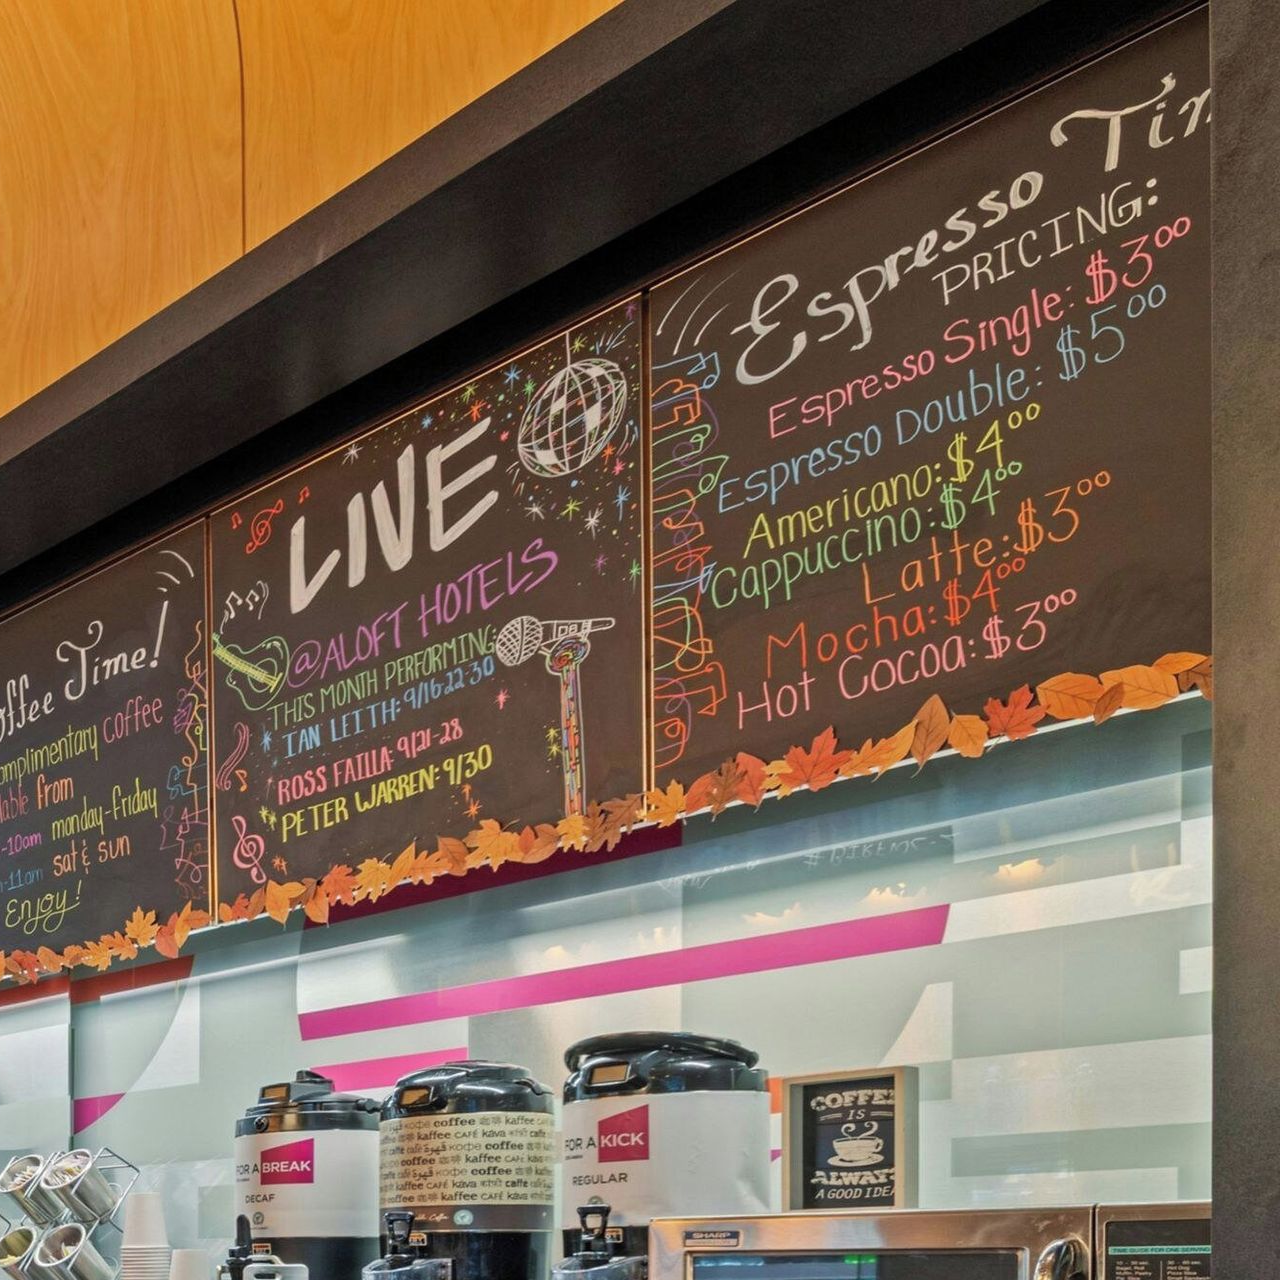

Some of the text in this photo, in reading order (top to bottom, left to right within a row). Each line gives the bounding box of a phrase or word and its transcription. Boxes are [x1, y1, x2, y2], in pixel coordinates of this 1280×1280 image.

[933, 177, 1158, 305] PRICING:
[731, 171, 1043, 385] Espresso
[769, 349, 935, 439] Espresso
[944, 284, 1074, 365] Single:
[717, 423, 882, 514] Espresso
[897, 363, 1042, 445] Double:
[289, 416, 500, 614] LIVE
[743, 462, 942, 558] Americano:
[862, 529, 1011, 604] Latte:
[287, 538, 559, 688] @ALOFT HOTELS
[56, 600, 169, 701] Time!
[767, 606, 937, 679] Mocha:
[267, 626, 499, 732] THIS MONTH PERFORMING:
[738, 671, 815, 730] Hot
[839, 632, 976, 699] Cocoa:
[103, 696, 163, 744] coffee
[282, 723, 321, 759] IAN
[331, 697, 402, 742] LEITH:
[36, 773, 75, 811] from
[278, 766, 327, 806] ROSS
[281, 744, 494, 842] PETER WARREN: 9/30
[52, 777, 159, 841] monday-friday
[53, 840, 78, 877] sat
[99, 834, 131, 864] sun
[433, 1116, 477, 1128] coffee
[504, 1116, 535, 1126] kaffee
[847, 1109, 866, 1120] IS
[416, 1131, 452, 1142] kaffee
[481, 1129, 507, 1138] kava
[484, 1139, 525, 1150] coffee
[565, 1132, 645, 1151] FOR A KICK
[251, 1163, 260, 1174] A
[262, 1160, 311, 1174] BREAK
[400, 1155, 436, 1167] coffee
[465, 1153, 502, 1164] kaffee
[470, 1165, 513, 1176] coffee
[572, 1172, 629, 1186] REGULAR
[245, 1193, 276, 1204] DECAF
[396, 1180, 424, 1191] kaffee
[452, 1179, 477, 1189] kava
[441, 1190, 478, 1201] kaffee
[815, 1189, 825, 1199] A
[827, 1188, 862, 1200] GOOD
